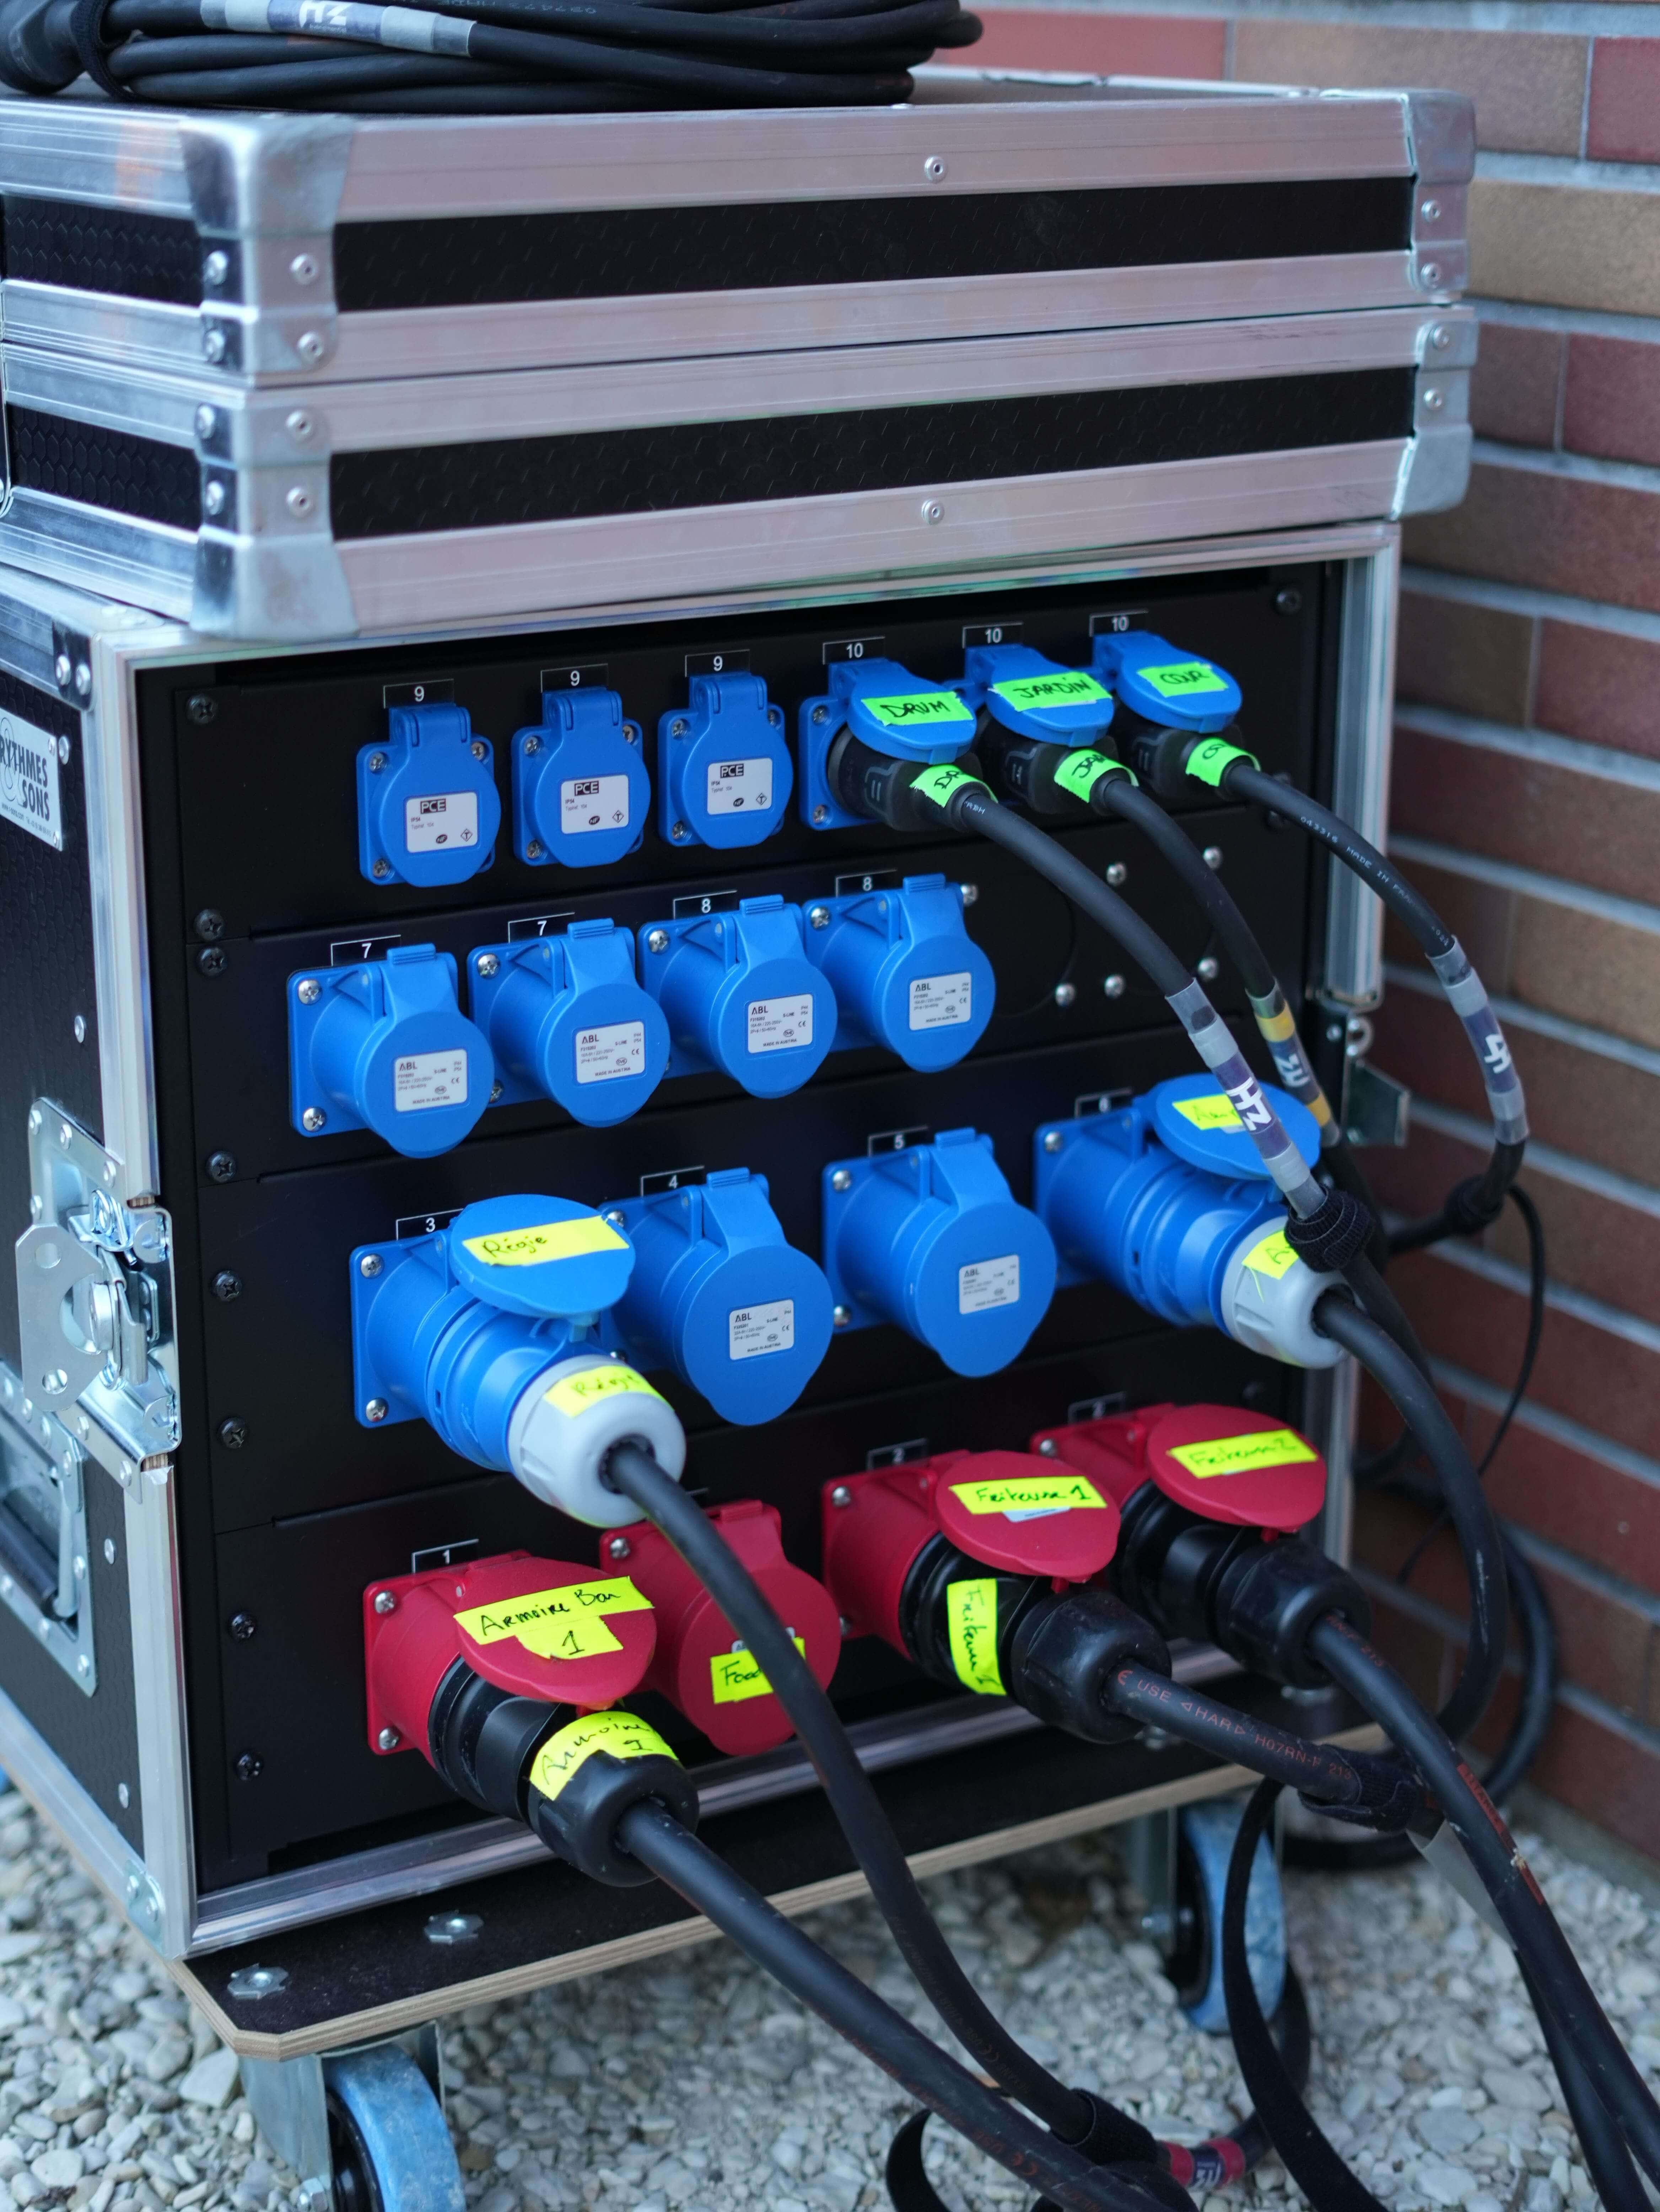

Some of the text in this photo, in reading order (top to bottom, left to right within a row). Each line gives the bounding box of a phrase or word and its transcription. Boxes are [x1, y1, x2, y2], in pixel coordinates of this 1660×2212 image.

[1112, 616, 1128, 632] 10
[985, 628, 1002, 643] 10
[846, 643, 863, 658] 10
[713, 656, 723, 671] 9
[570, 670, 580, 686] 9
[414, 686, 424, 702] 9
[880, 701, 950, 718] DRUM
[721, 764, 744, 778] PCE
[575, 781, 599, 796] PCE
[22, 779, 50, 822] SONS
[421, 800, 446, 814] PCE
[863, 876, 872, 891] 8
[1376, 870, 1390, 883] IN
[701, 898, 711, 913] 8
[538, 920, 547, 936] 7
[362, 943, 372, 959] 7
[915, 982, 931, 992] ABL
[751, 1005, 769, 1015] ABL
[582, 1034, 599, 1045] ABL
[399, 1061, 418, 1072] ABL
[1225, 1076, 1273, 1132] HZ
[894, 1134, 904, 1149] 5
[669, 1175, 678, 1189] 4
[426, 1217, 435, 1233] 3
[964, 1268, 980, 1278] ABL
[735, 1312, 752, 1323] ABL
[1070, 1484, 1092, 1500] 1
[443, 1549, 450, 1564] 1
[561, 1630, 585, 1655] 1
[1137, 1679, 1172, 1703] USE
[1195, 1706, 1233, 1732] HAR
[623, 1739, 653, 1751] 1
